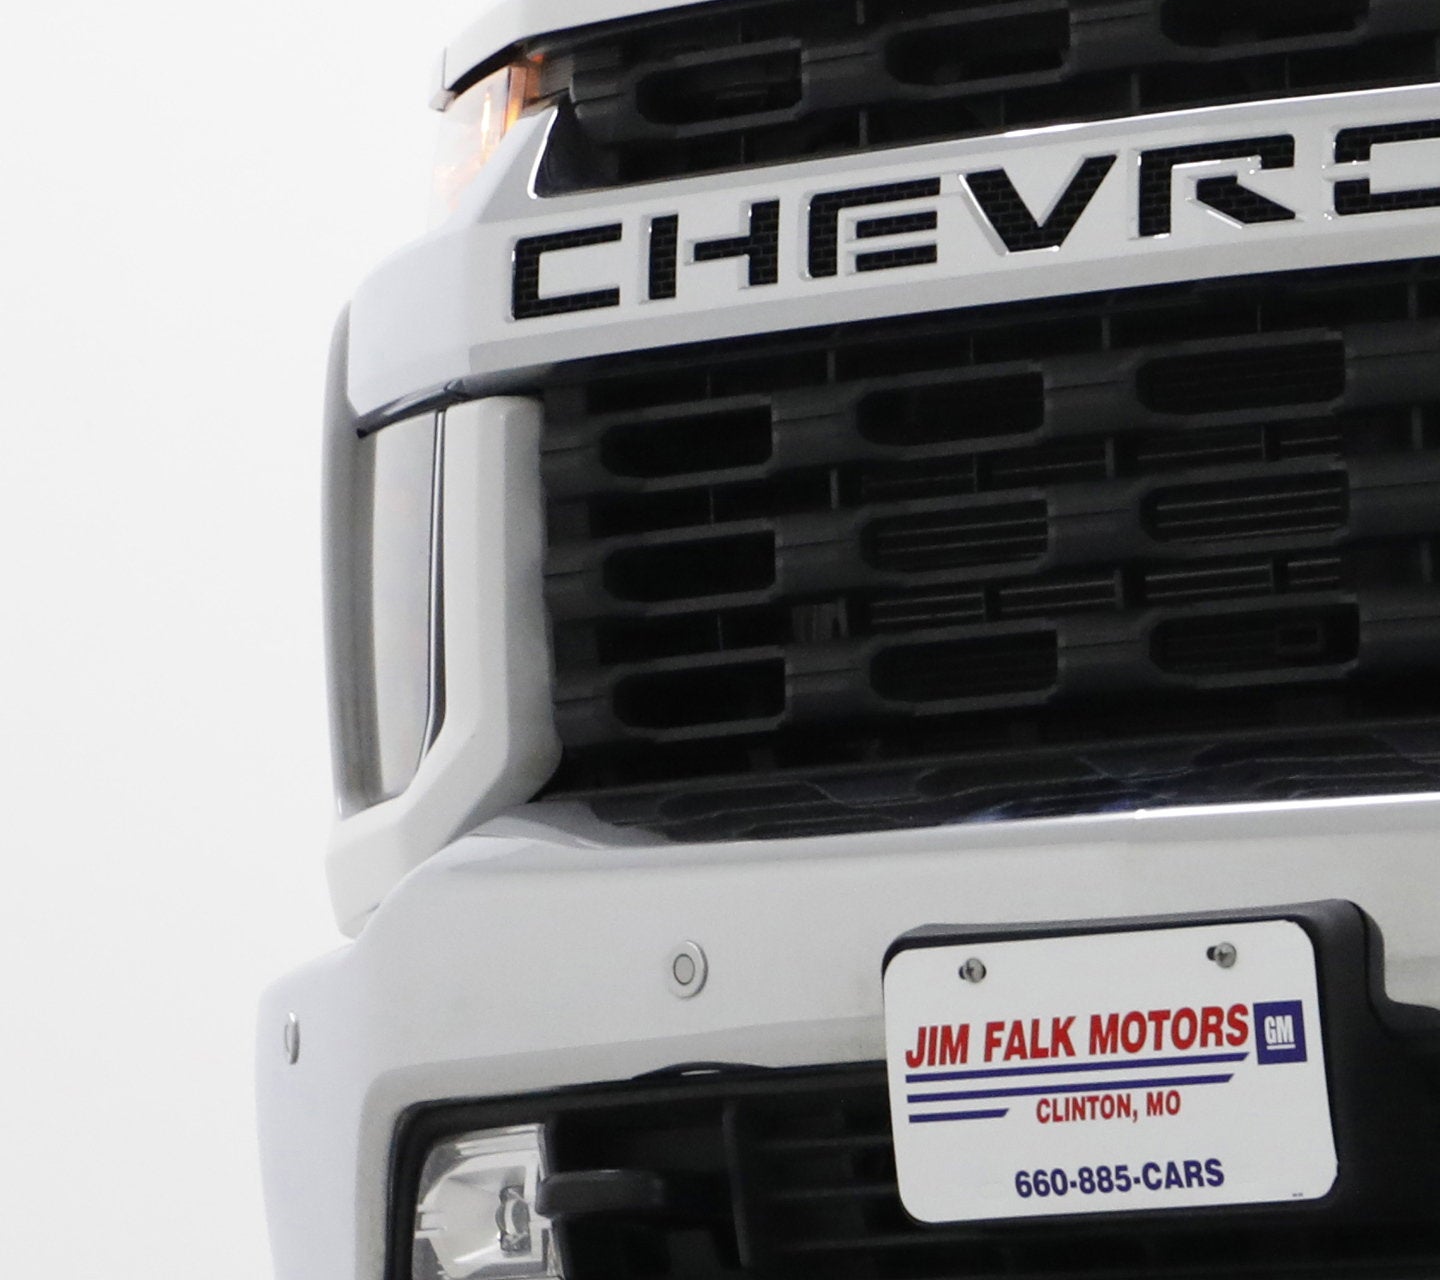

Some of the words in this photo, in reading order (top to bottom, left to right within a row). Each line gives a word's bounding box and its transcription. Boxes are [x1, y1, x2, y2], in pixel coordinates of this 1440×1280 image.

[905, 1023, 969, 1068] JIM
[983, 1016, 1076, 1062] FALK
[1089, 1003, 1249, 1054] MOTORS
[1264, 1014, 1294, 1045] GM
[1036, 1092, 1137, 1124] CLINTON,
[1146, 1090, 1181, 1116] MO
[1015, 1158, 1225, 1198] 660-885-CARS
